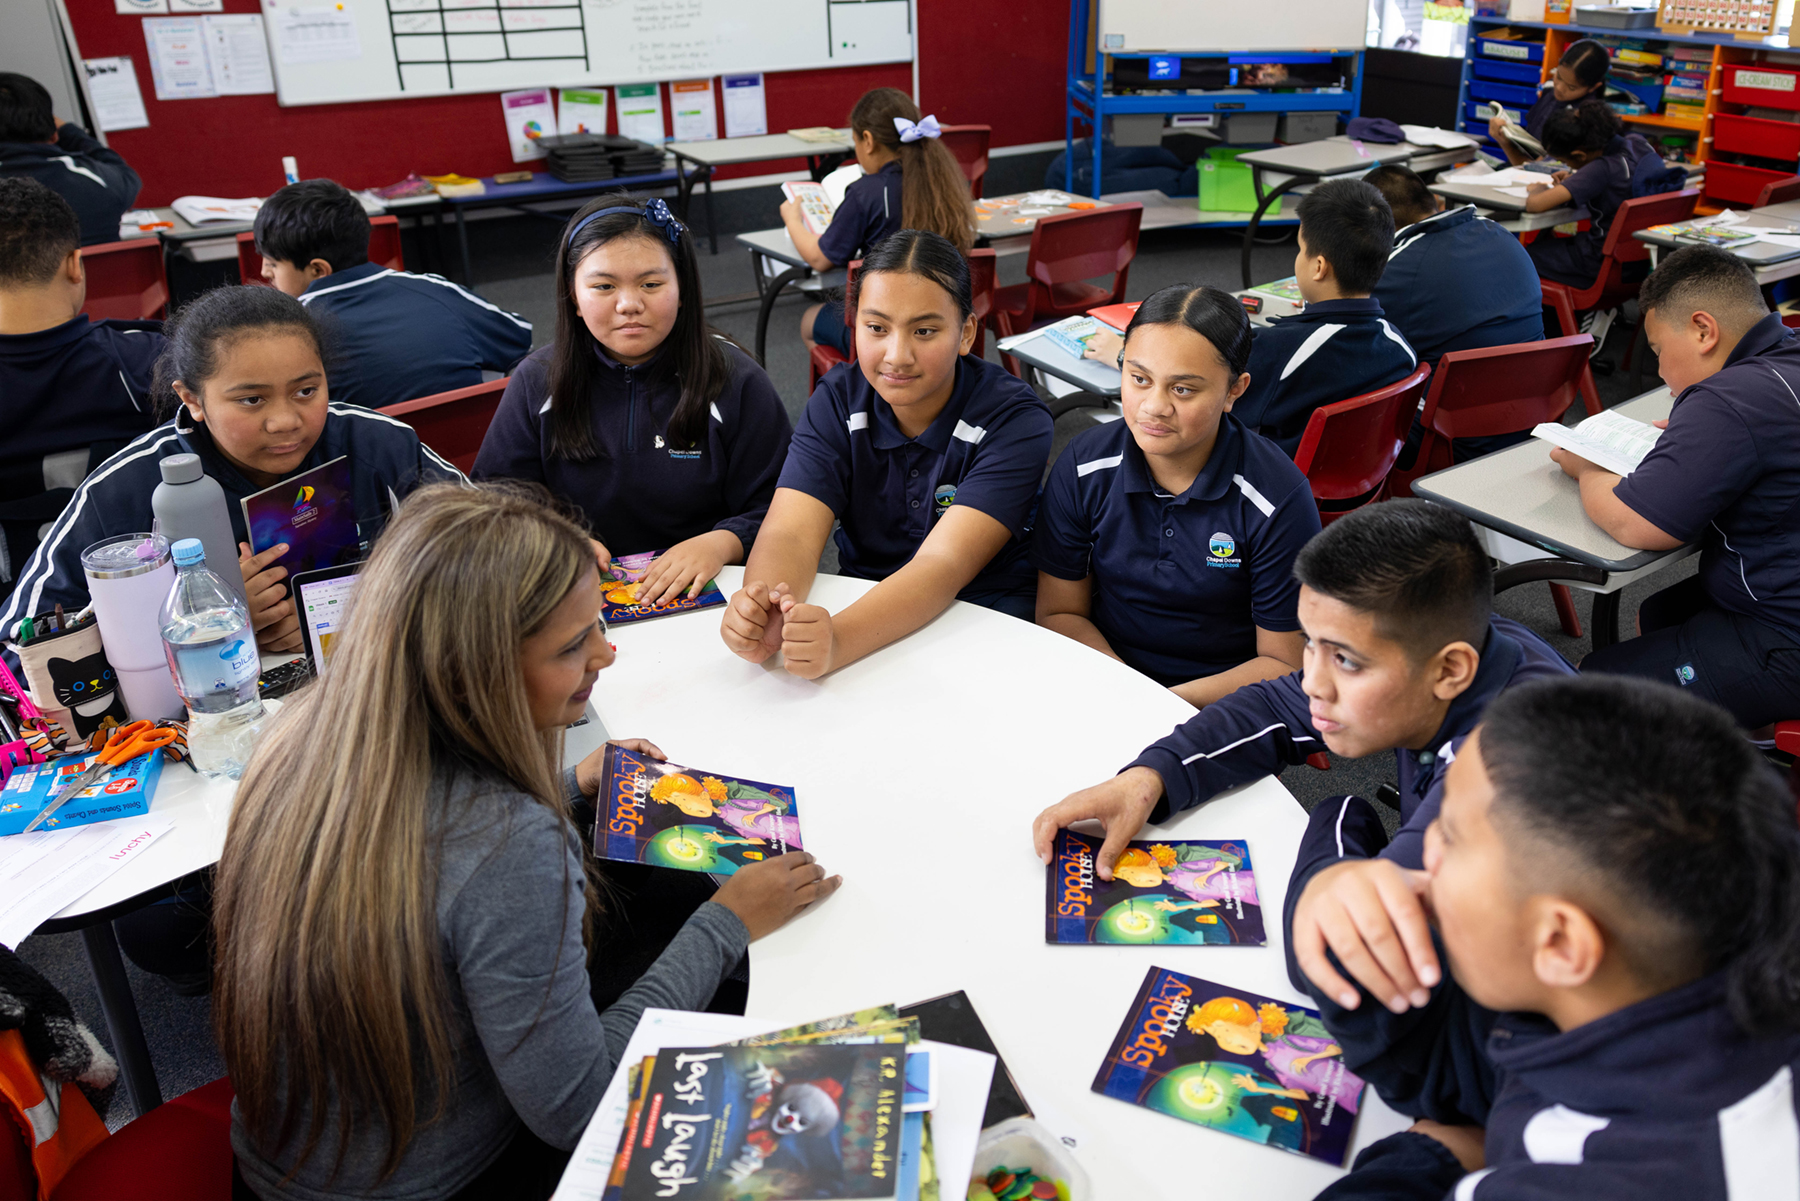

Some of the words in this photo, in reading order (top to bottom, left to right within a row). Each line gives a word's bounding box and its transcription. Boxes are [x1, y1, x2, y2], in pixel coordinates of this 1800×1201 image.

[1484, 45, 1527, 58] ABACUSES
[1738, 74, 1771, 86] ICE-CREAM
[1773, 76, 1795, 89] STICKS
[232, 650, 255, 670] blue
[609, 752, 646, 835] Spooky
[633, 772, 647, 809] HOUSE
[64, 811, 86, 820] Chants
[87, 809, 99, 817] and
[99, 804, 122, 815] Sounds
[123, 801, 141, 811] Speed
[1058, 834, 1092, 916] Spooky
[1080, 853, 1093, 889] HOUSE
[1121, 974, 1193, 1067] Spooky
[1160, 995, 1190, 1039] HOUSE
[673, 1052, 724, 1105] Last
[1333, 1063, 1345, 1086] Richard
[1316, 1083, 1328, 1100] Carol
[1331, 1086, 1339, 1095] by
[1313, 1099, 1325, 1109] By
[1321, 1094, 1337, 1126] Illustrated
[871, 1088, 897, 1179] Alexander
[650, 1111, 712, 1197] Laugh
